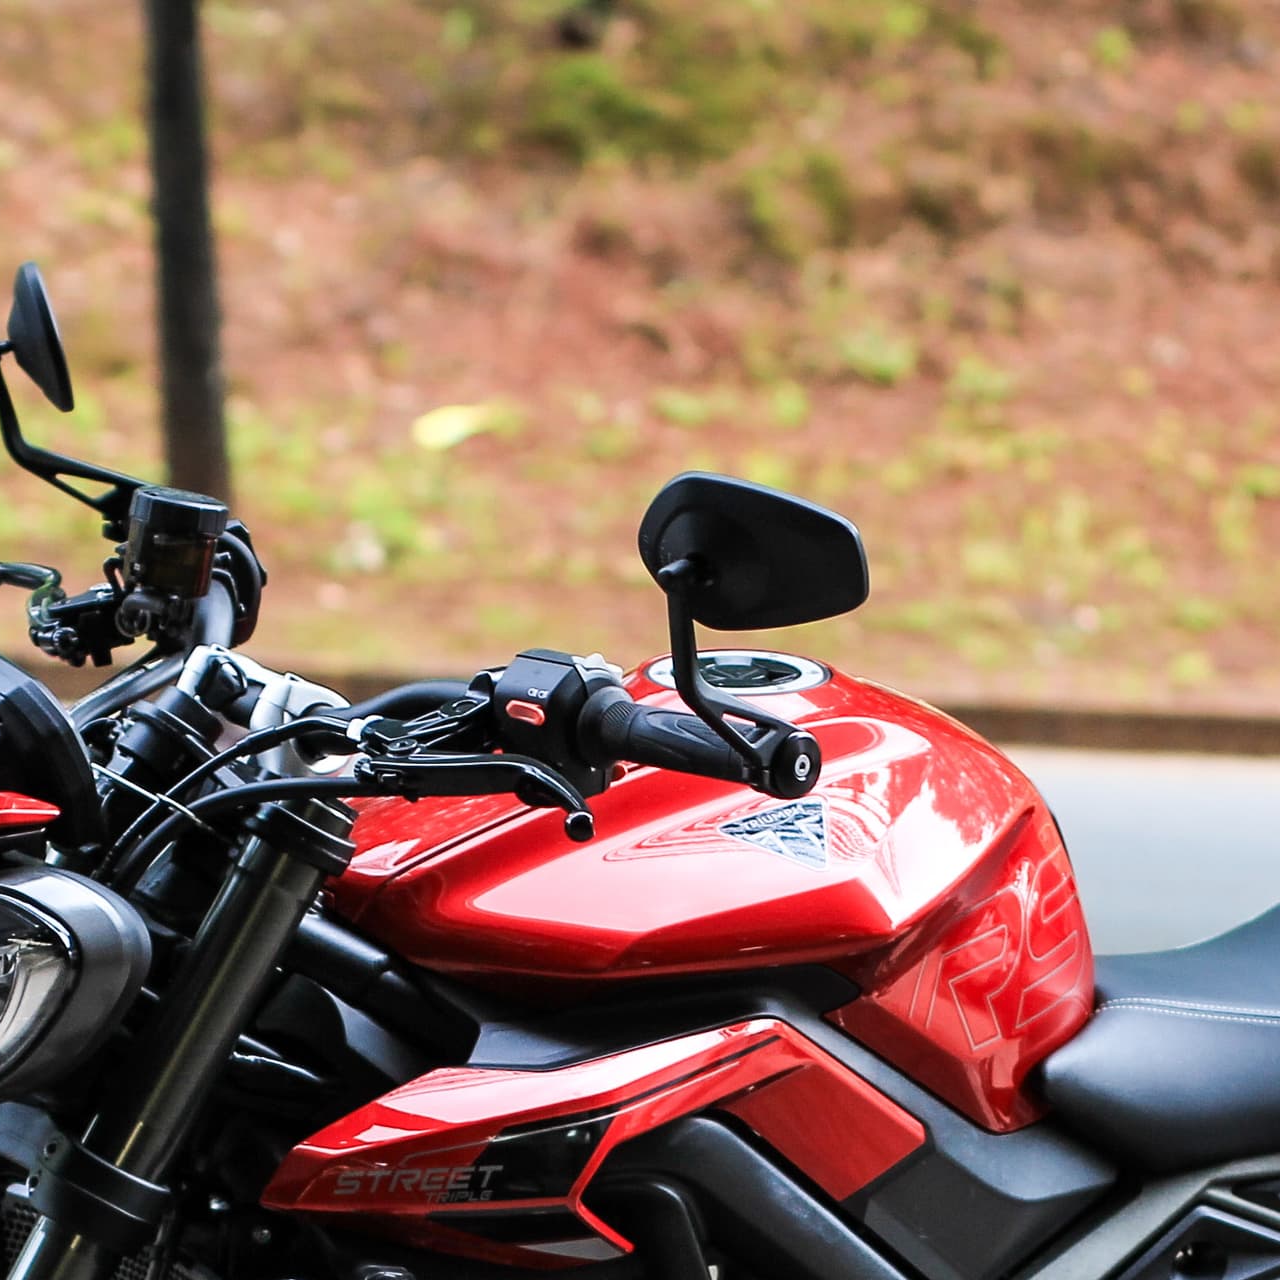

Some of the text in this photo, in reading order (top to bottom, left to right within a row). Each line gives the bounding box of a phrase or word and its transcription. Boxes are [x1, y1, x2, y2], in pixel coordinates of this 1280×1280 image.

[742, 803, 805, 830] TRIUMPH
[333, 1164, 503, 1196] STREET
[425, 1189, 494, 1204] TRIPLE
